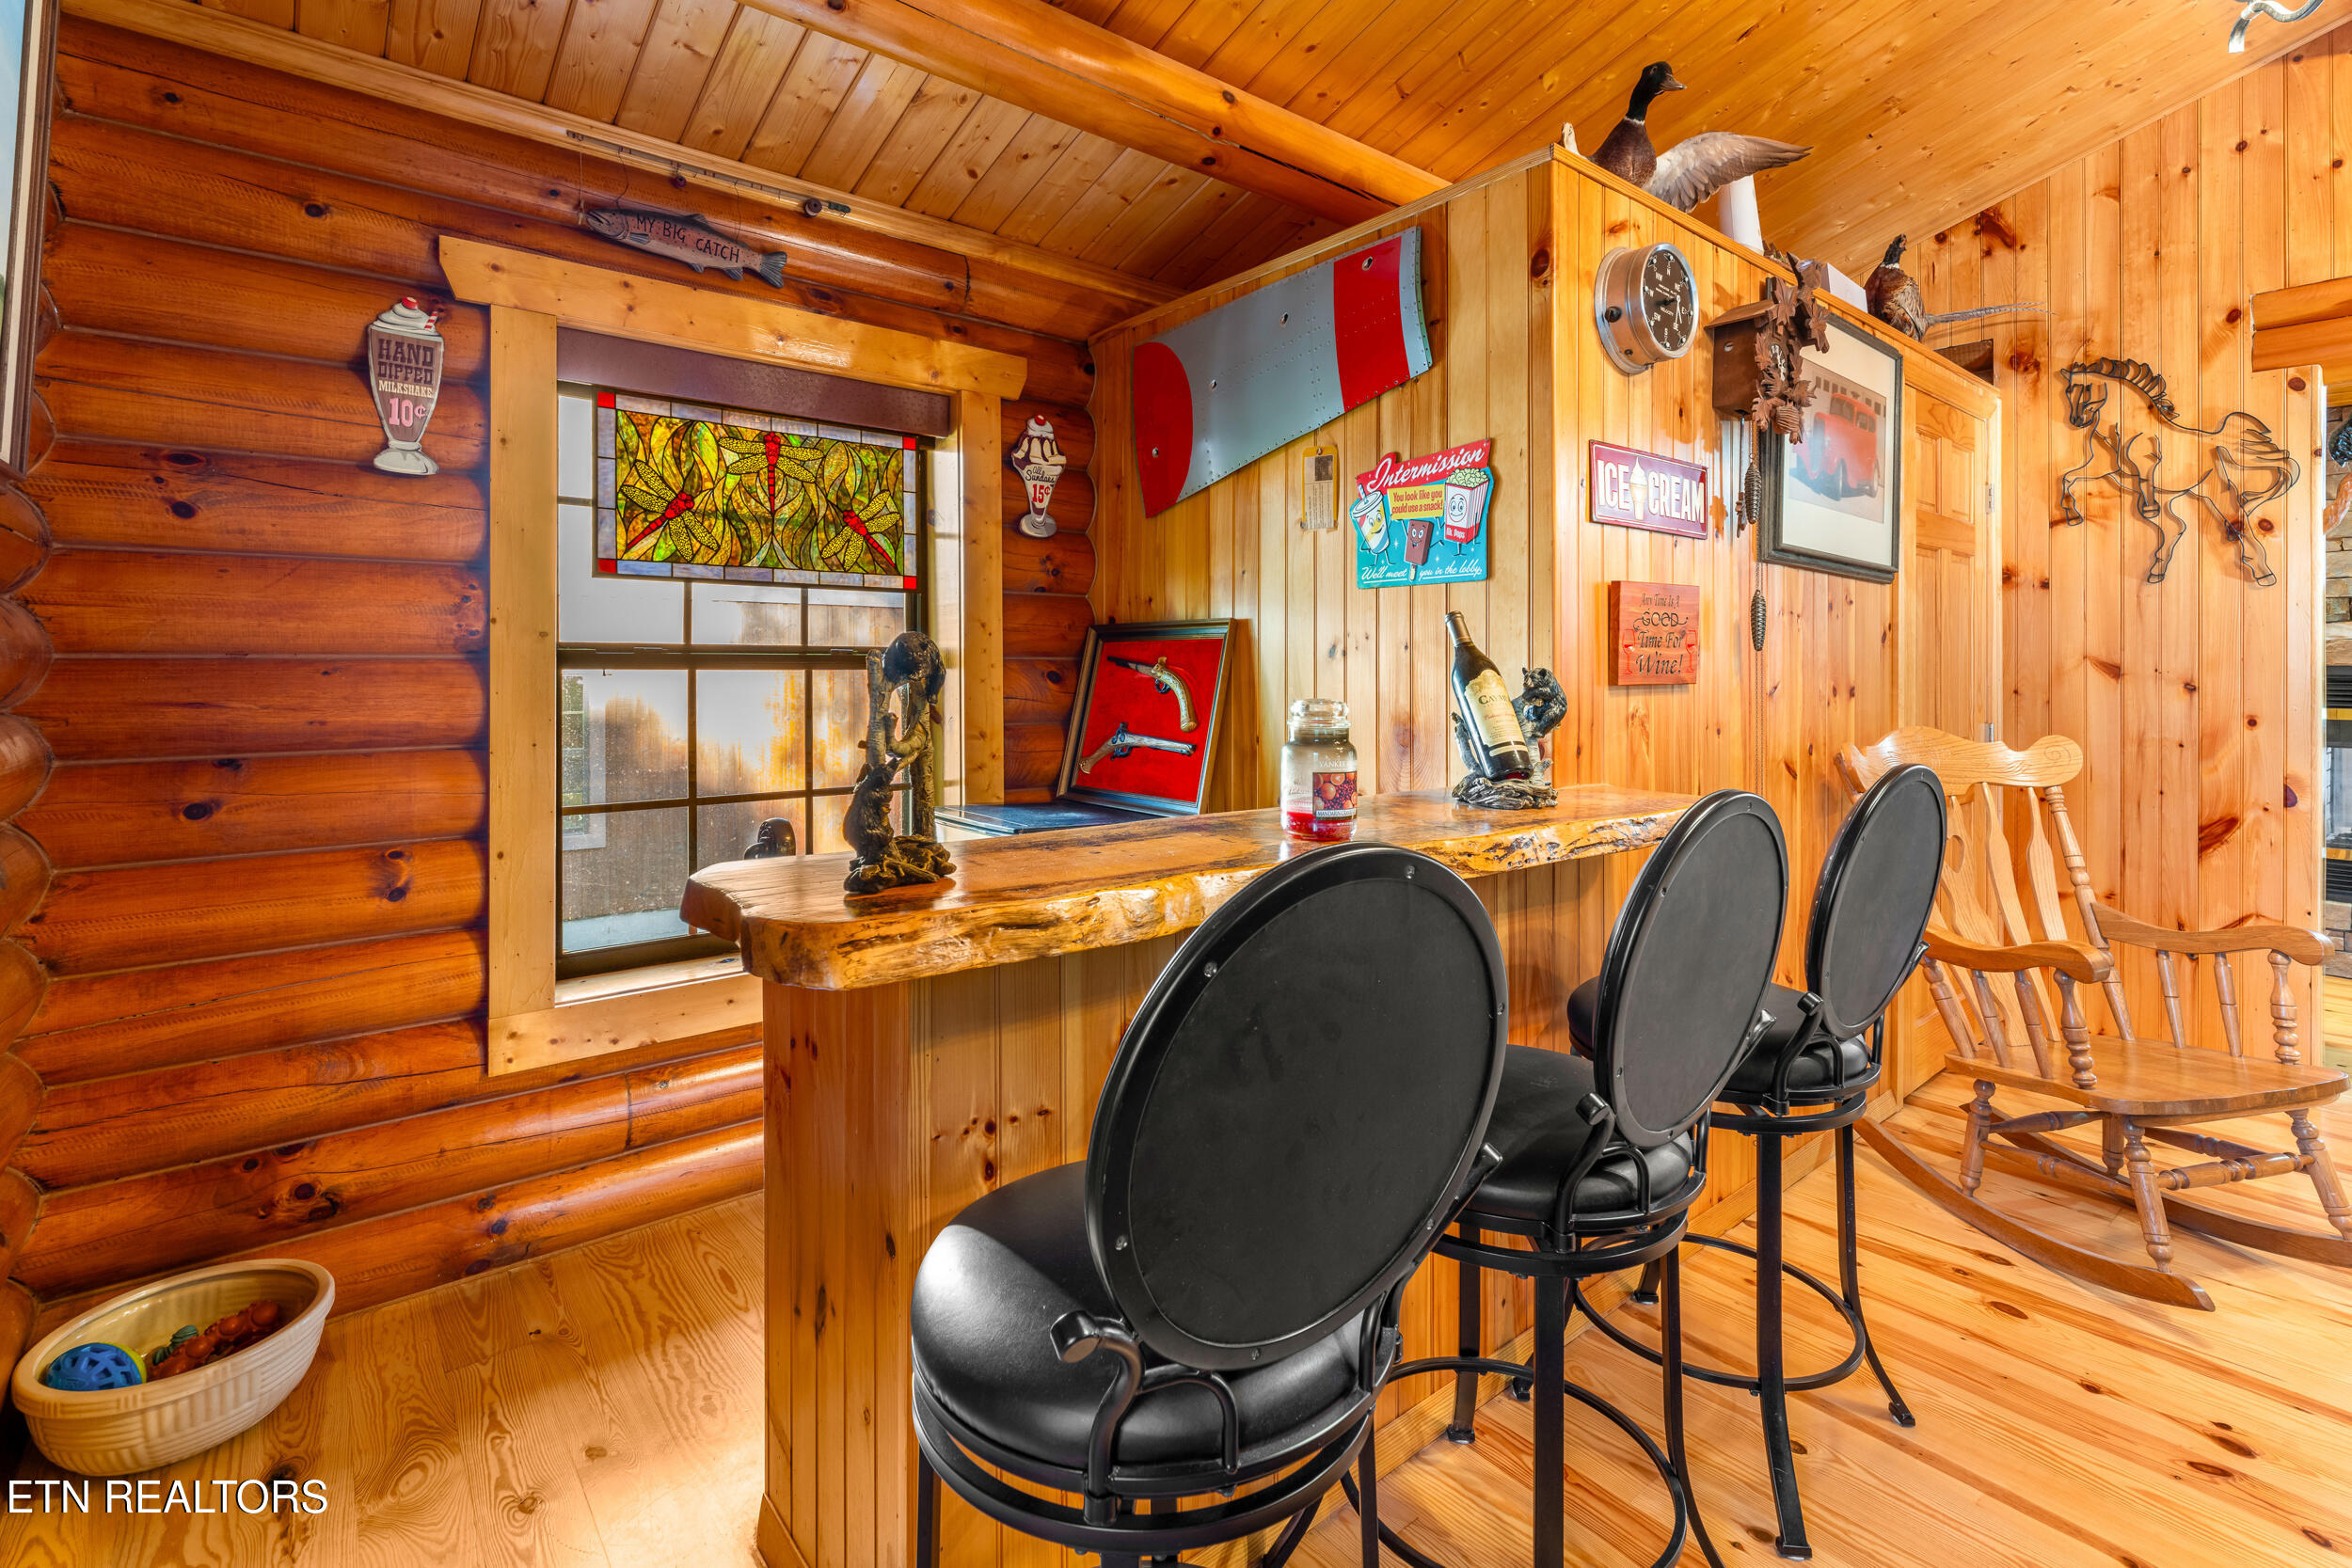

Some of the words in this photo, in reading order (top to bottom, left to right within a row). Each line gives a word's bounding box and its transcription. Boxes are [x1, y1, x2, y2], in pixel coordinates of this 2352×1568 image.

[636, 214, 656, 232] MY
[662, 221, 687, 244] BIG
[695, 238, 740, 263] CATCH
[377, 339, 435, 367] HAND
[377, 361, 435, 385] DIPPED
[378, 380, 435, 398] MILKSHAKE
[389, 397, 427, 427] 10¢
[1025, 469, 1055, 483] Sundaes
[1366, 448, 1486, 493] Intermission
[1032, 483, 1051, 503] 15¢
[1392, 492, 1404, 502] You
[1405, 490, 1418, 501] look
[1419, 489, 1430, 499] like
[1431, 490, 1442, 501] you
[1597, 459, 1630, 512] ICE
[1647, 471, 1705, 524] CREAM
[1391, 502, 1407, 514] could
[1408, 504, 1419, 513] use
[1423, 499, 1443, 512] snack!
[1386, 567, 1407, 578] meet
[1419, 569, 1434, 581] you
[1444, 561, 1457, 574] the
[1640, 594, 1653, 608] Any
[1654, 594, 1668, 607] Time
[1638, 630, 1663, 648] Time
[1665, 631, 1684, 648] For
[1636, 651, 1683, 675] Wine!
